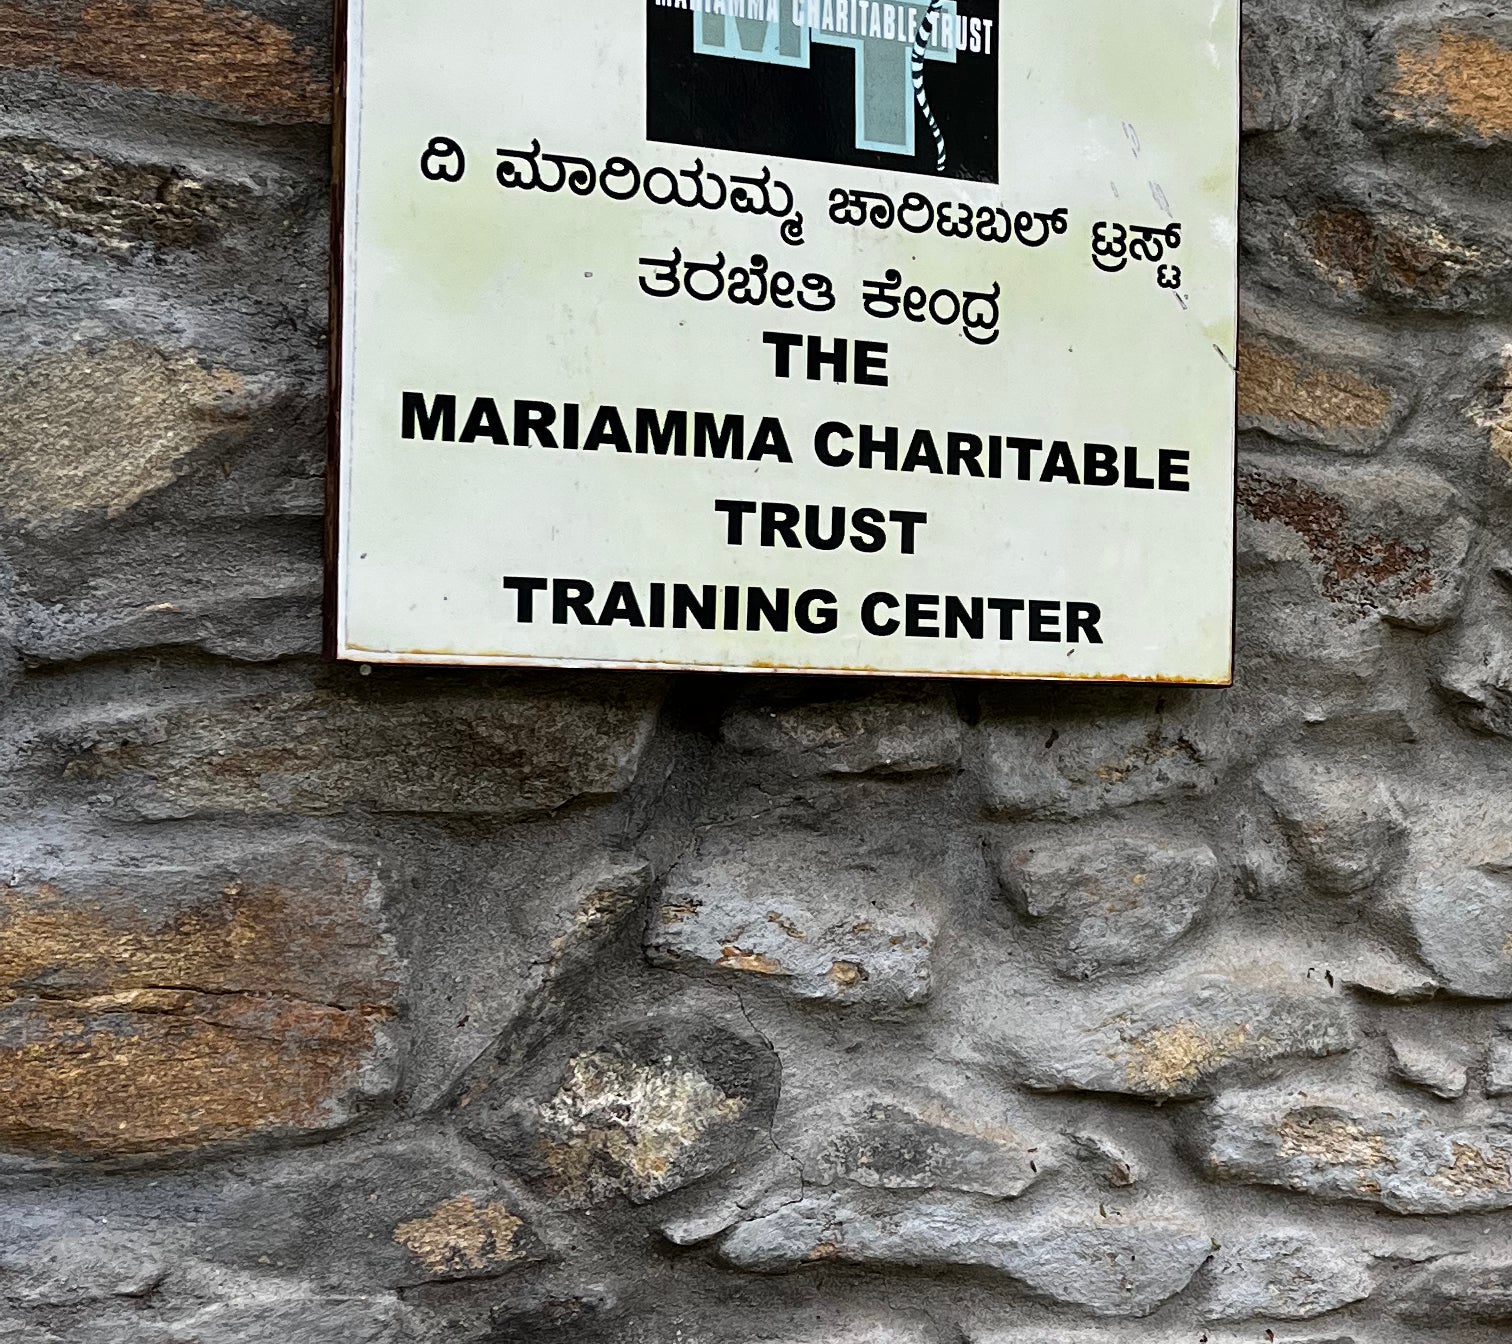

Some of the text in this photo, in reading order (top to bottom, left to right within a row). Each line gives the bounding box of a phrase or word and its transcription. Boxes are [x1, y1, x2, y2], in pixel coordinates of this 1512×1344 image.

[928, 9, 994, 55] TRUST
[420, 136, 1182, 290] ದಿ ಮಾರಿಯಮ್ಮ ಚಾರಿಟಬಲ್ ಟ್ರಸ್ಟ್
[638, 246, 1001, 345] ತರಬೇತಿ ಕೇಂದ್ರ
[762, 331, 889, 387] THE
[401, 391, 1190, 492] MARIAMMA CHARITABLE
[714, 499, 928, 555] TRUST
[503, 576, 1104, 644] TRAINING CENTER
